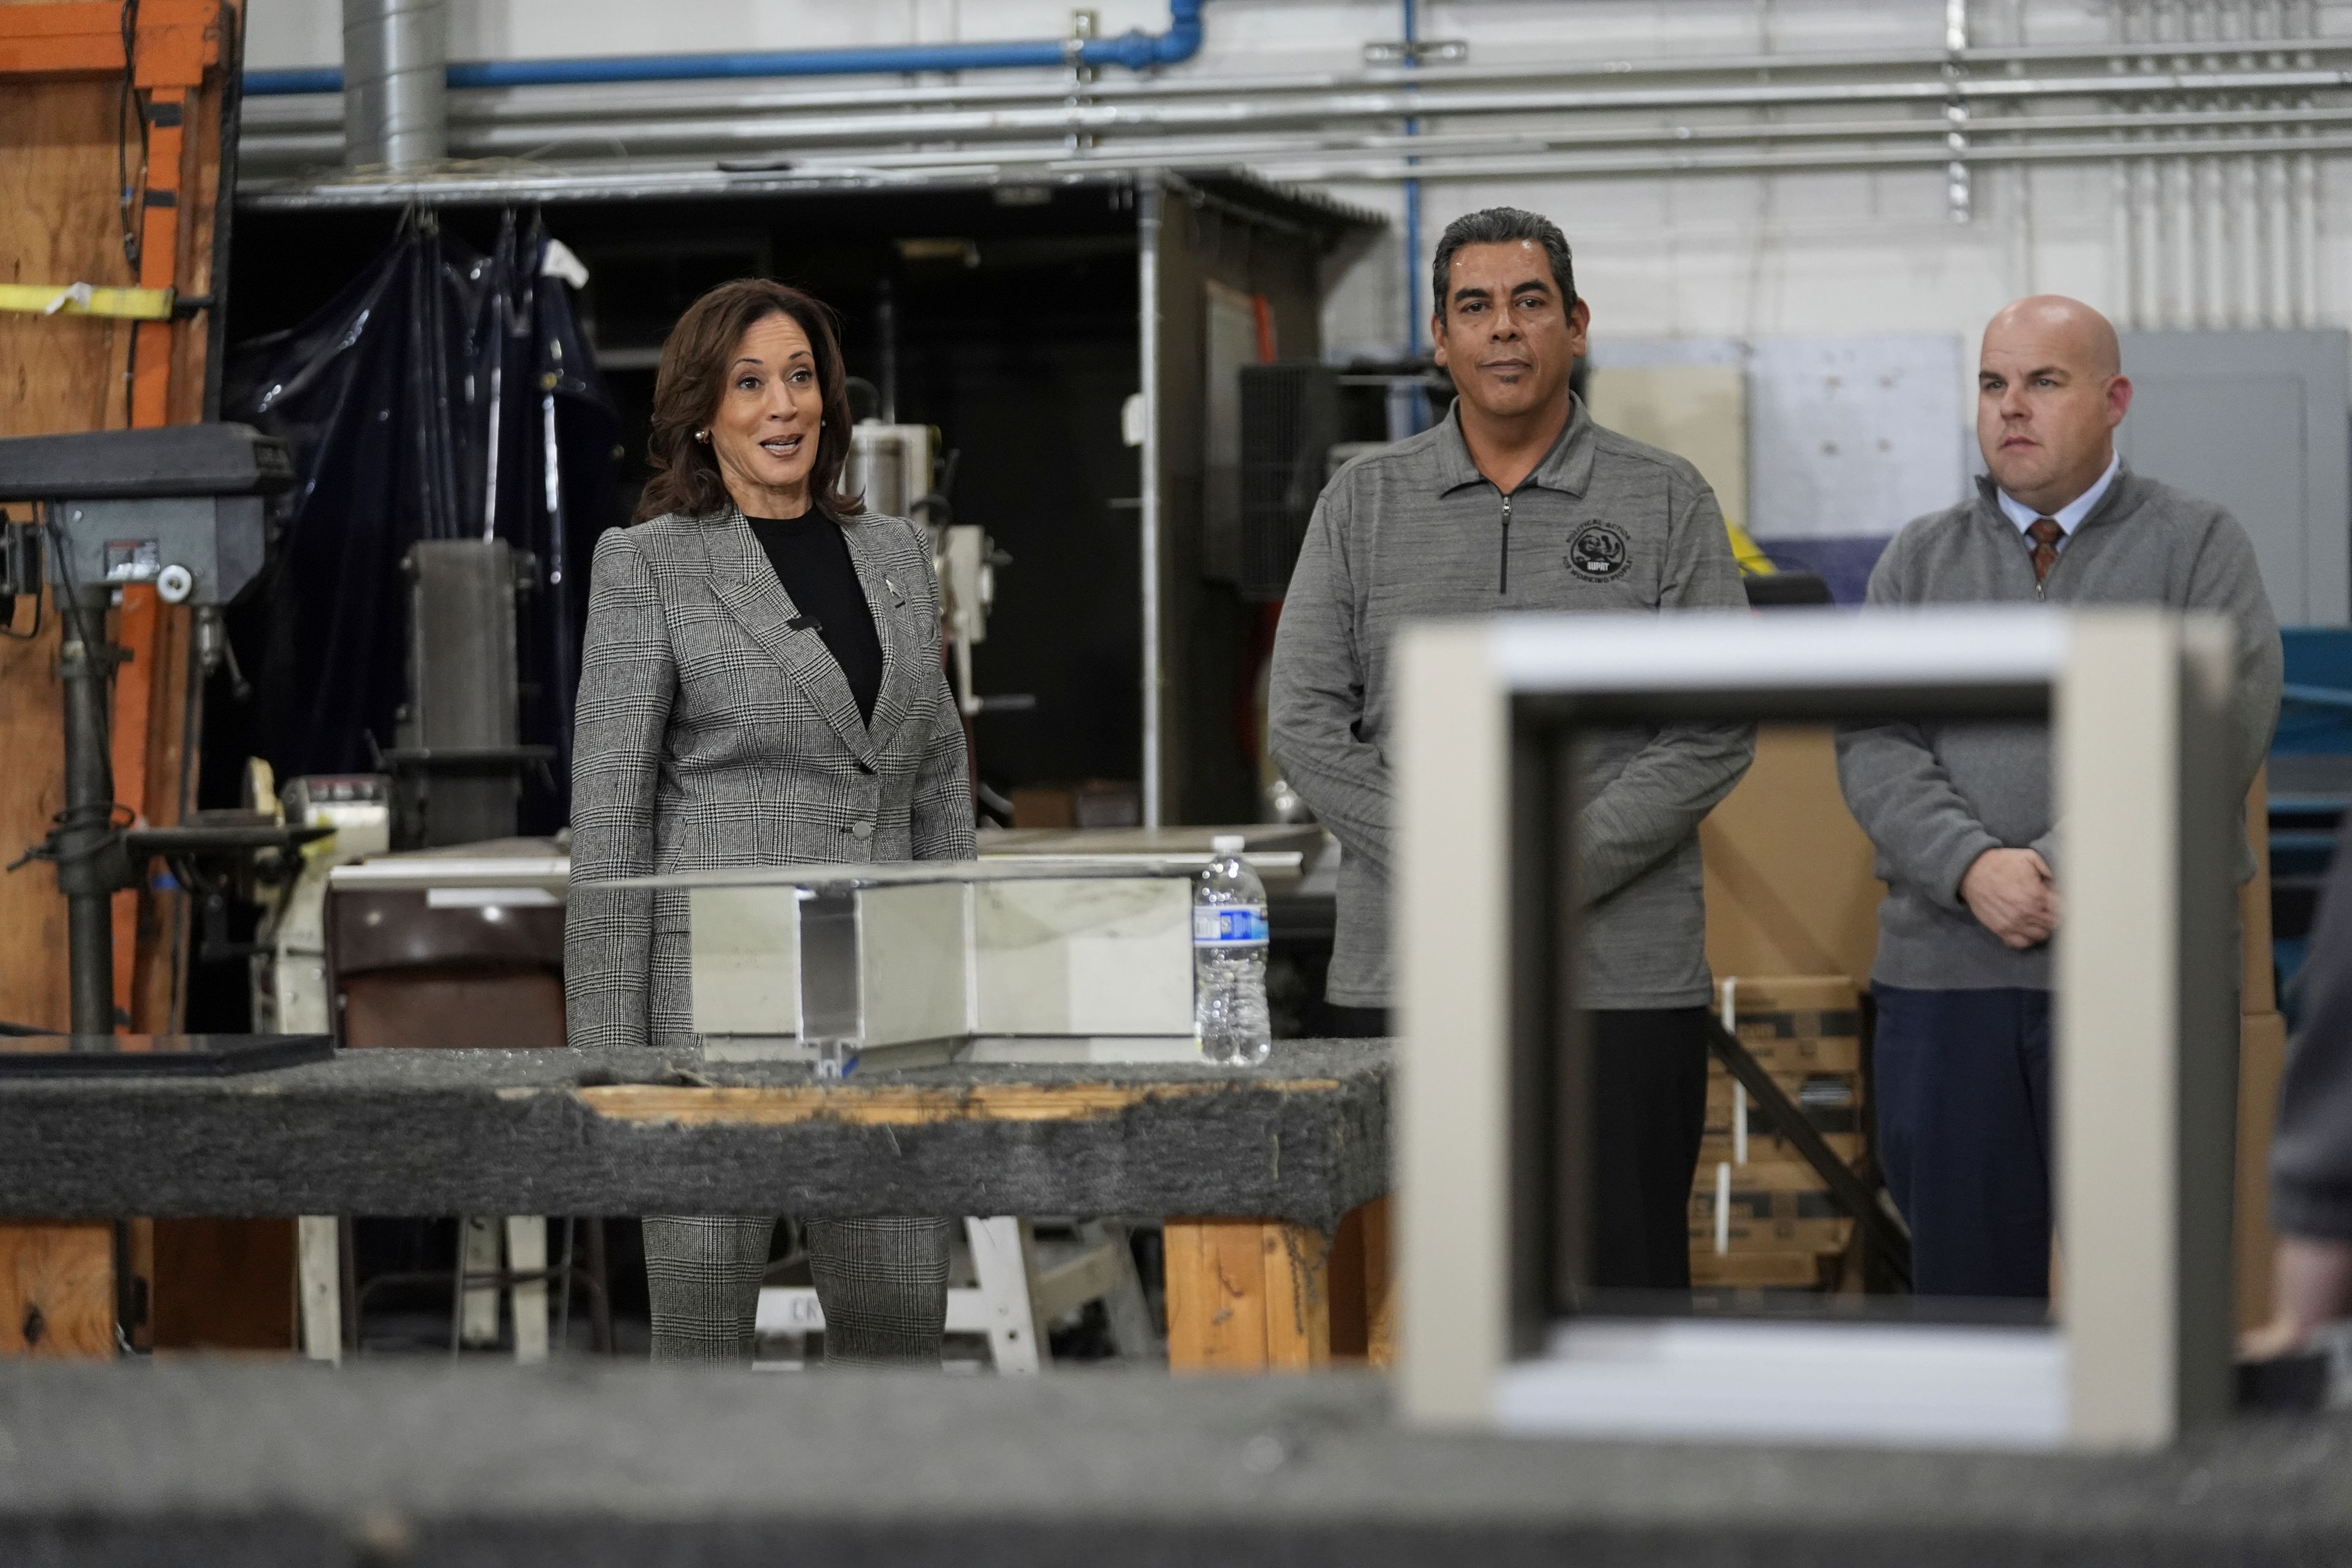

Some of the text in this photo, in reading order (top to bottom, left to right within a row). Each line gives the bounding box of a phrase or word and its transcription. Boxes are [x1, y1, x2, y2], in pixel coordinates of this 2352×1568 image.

[1566, 519, 1630, 543] POLITICAL ACTION
[1562, 556, 1571, 568] FOR
[1571, 570, 1609, 583] WORKING
[1588, 562, 1610, 571] IUPAT
